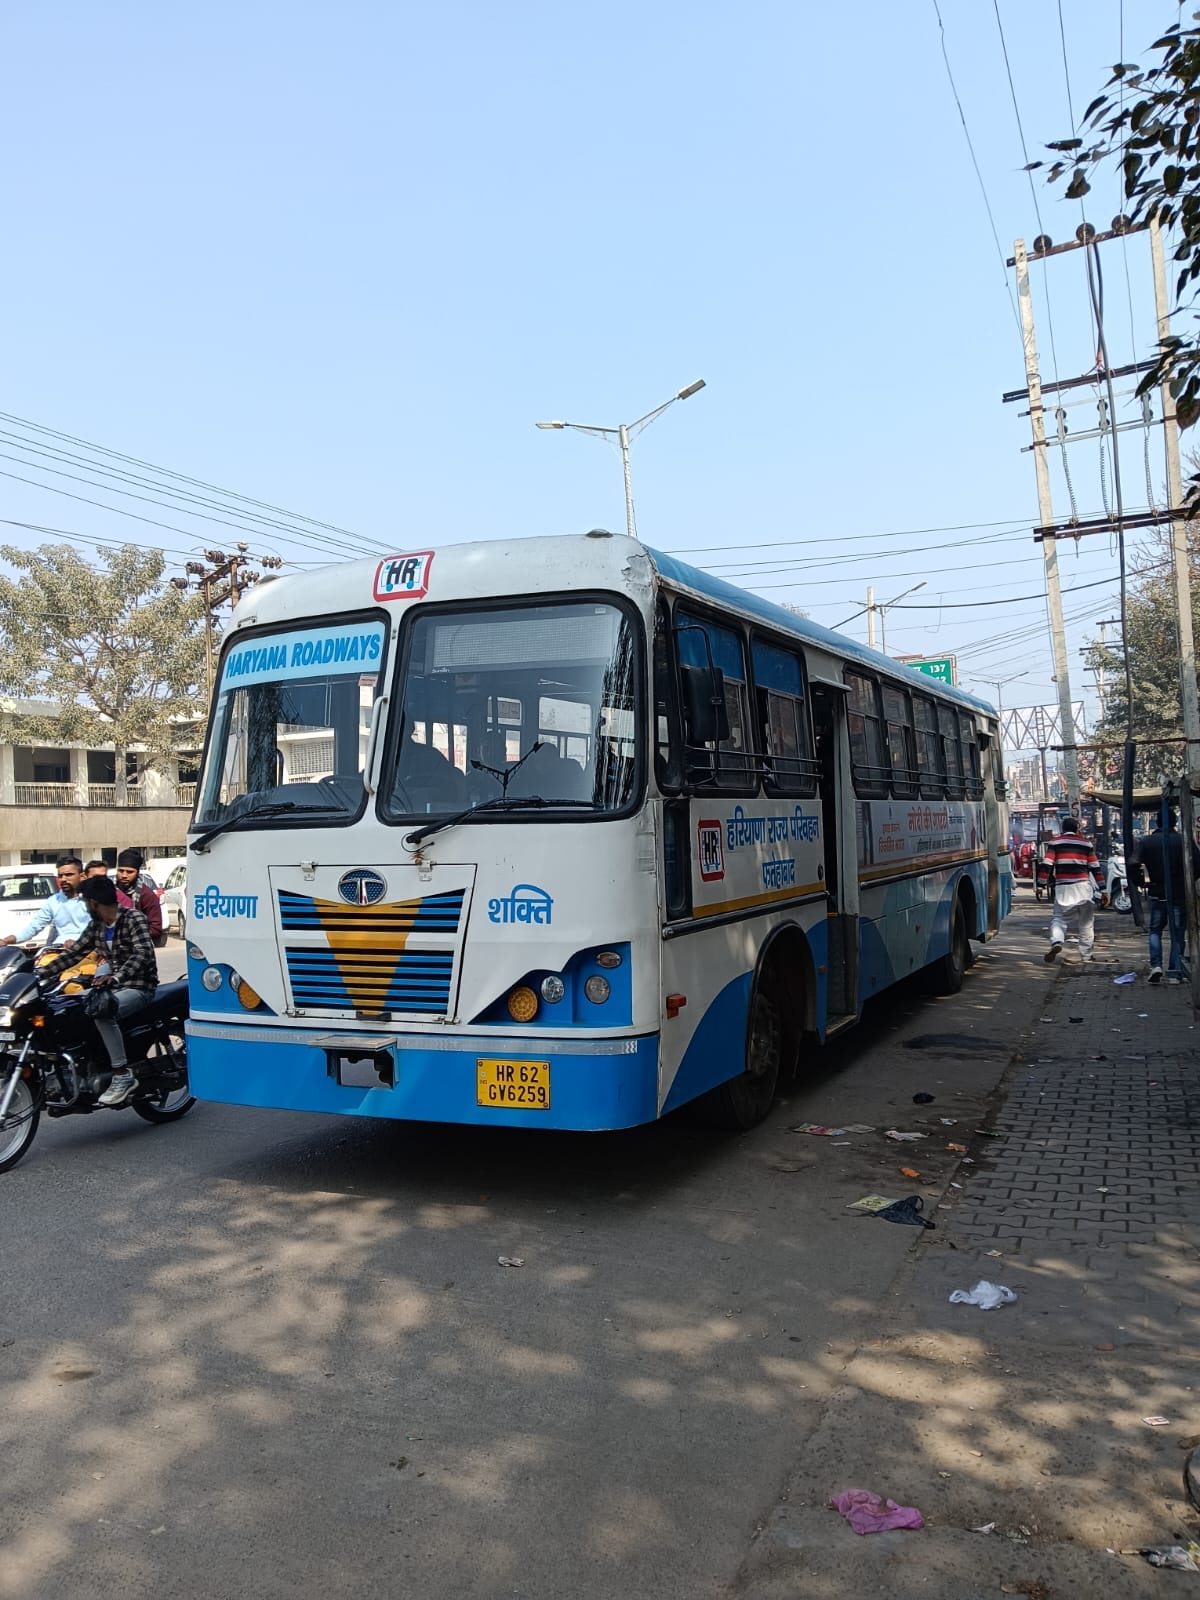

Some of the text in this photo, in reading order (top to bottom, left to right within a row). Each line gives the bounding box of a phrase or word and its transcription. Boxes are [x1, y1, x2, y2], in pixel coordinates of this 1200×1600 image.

[386, 558, 418, 586] HR
[226, 633, 380, 679] HARYANA ROADWAYS
[929, 663, 946, 674] 137
[726, 805, 819, 851] हरियाणा राज्य परिवहन
[704, 830, 719, 865] HR
[762, 848, 795, 889] फतेहाबाद
[194, 885, 258, 919] हरियाणा
[488, 883, 554, 924] शक्ति
[496, 1064, 539, 1083] HR 62
[489, 1084, 546, 1103] GV6259
